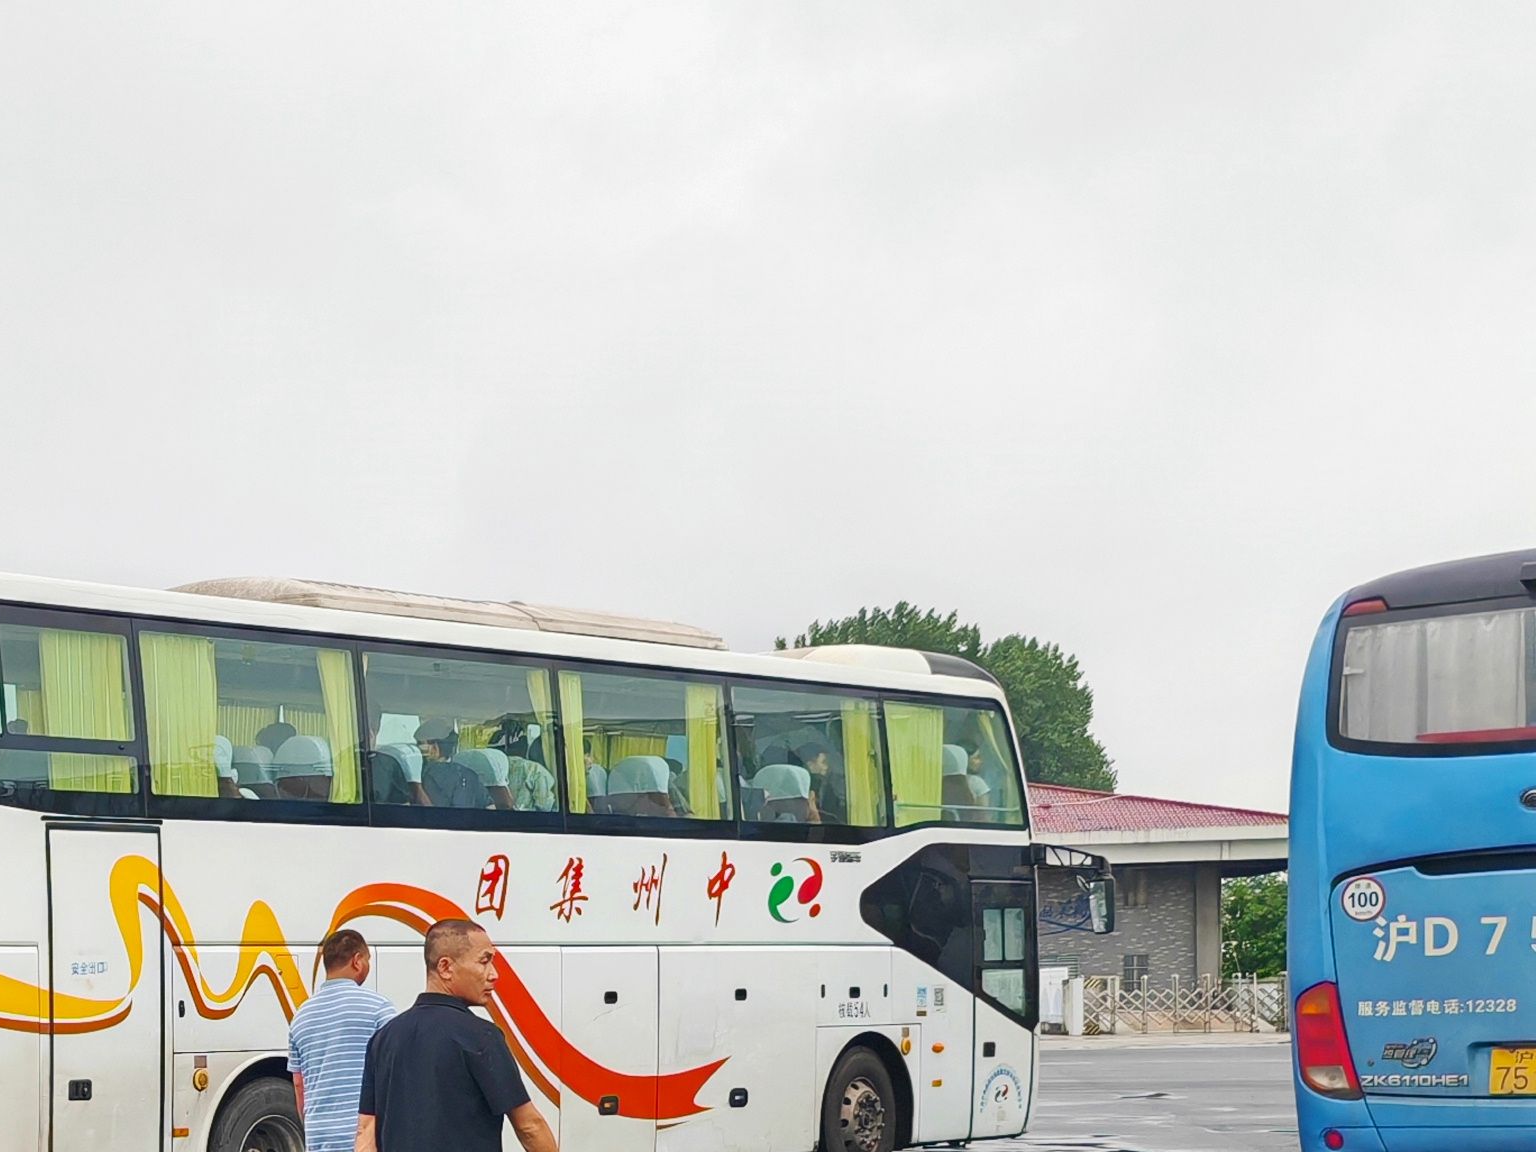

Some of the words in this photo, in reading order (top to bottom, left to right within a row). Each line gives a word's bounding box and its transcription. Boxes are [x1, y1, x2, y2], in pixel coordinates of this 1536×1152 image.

[1348, 891, 1379, 908] 100
[71, 961, 109, 976] 安全出口
[1357, 998, 1517, 1017] 服务监督电话:12328
[1495, 1066, 1536, 1091] 75
